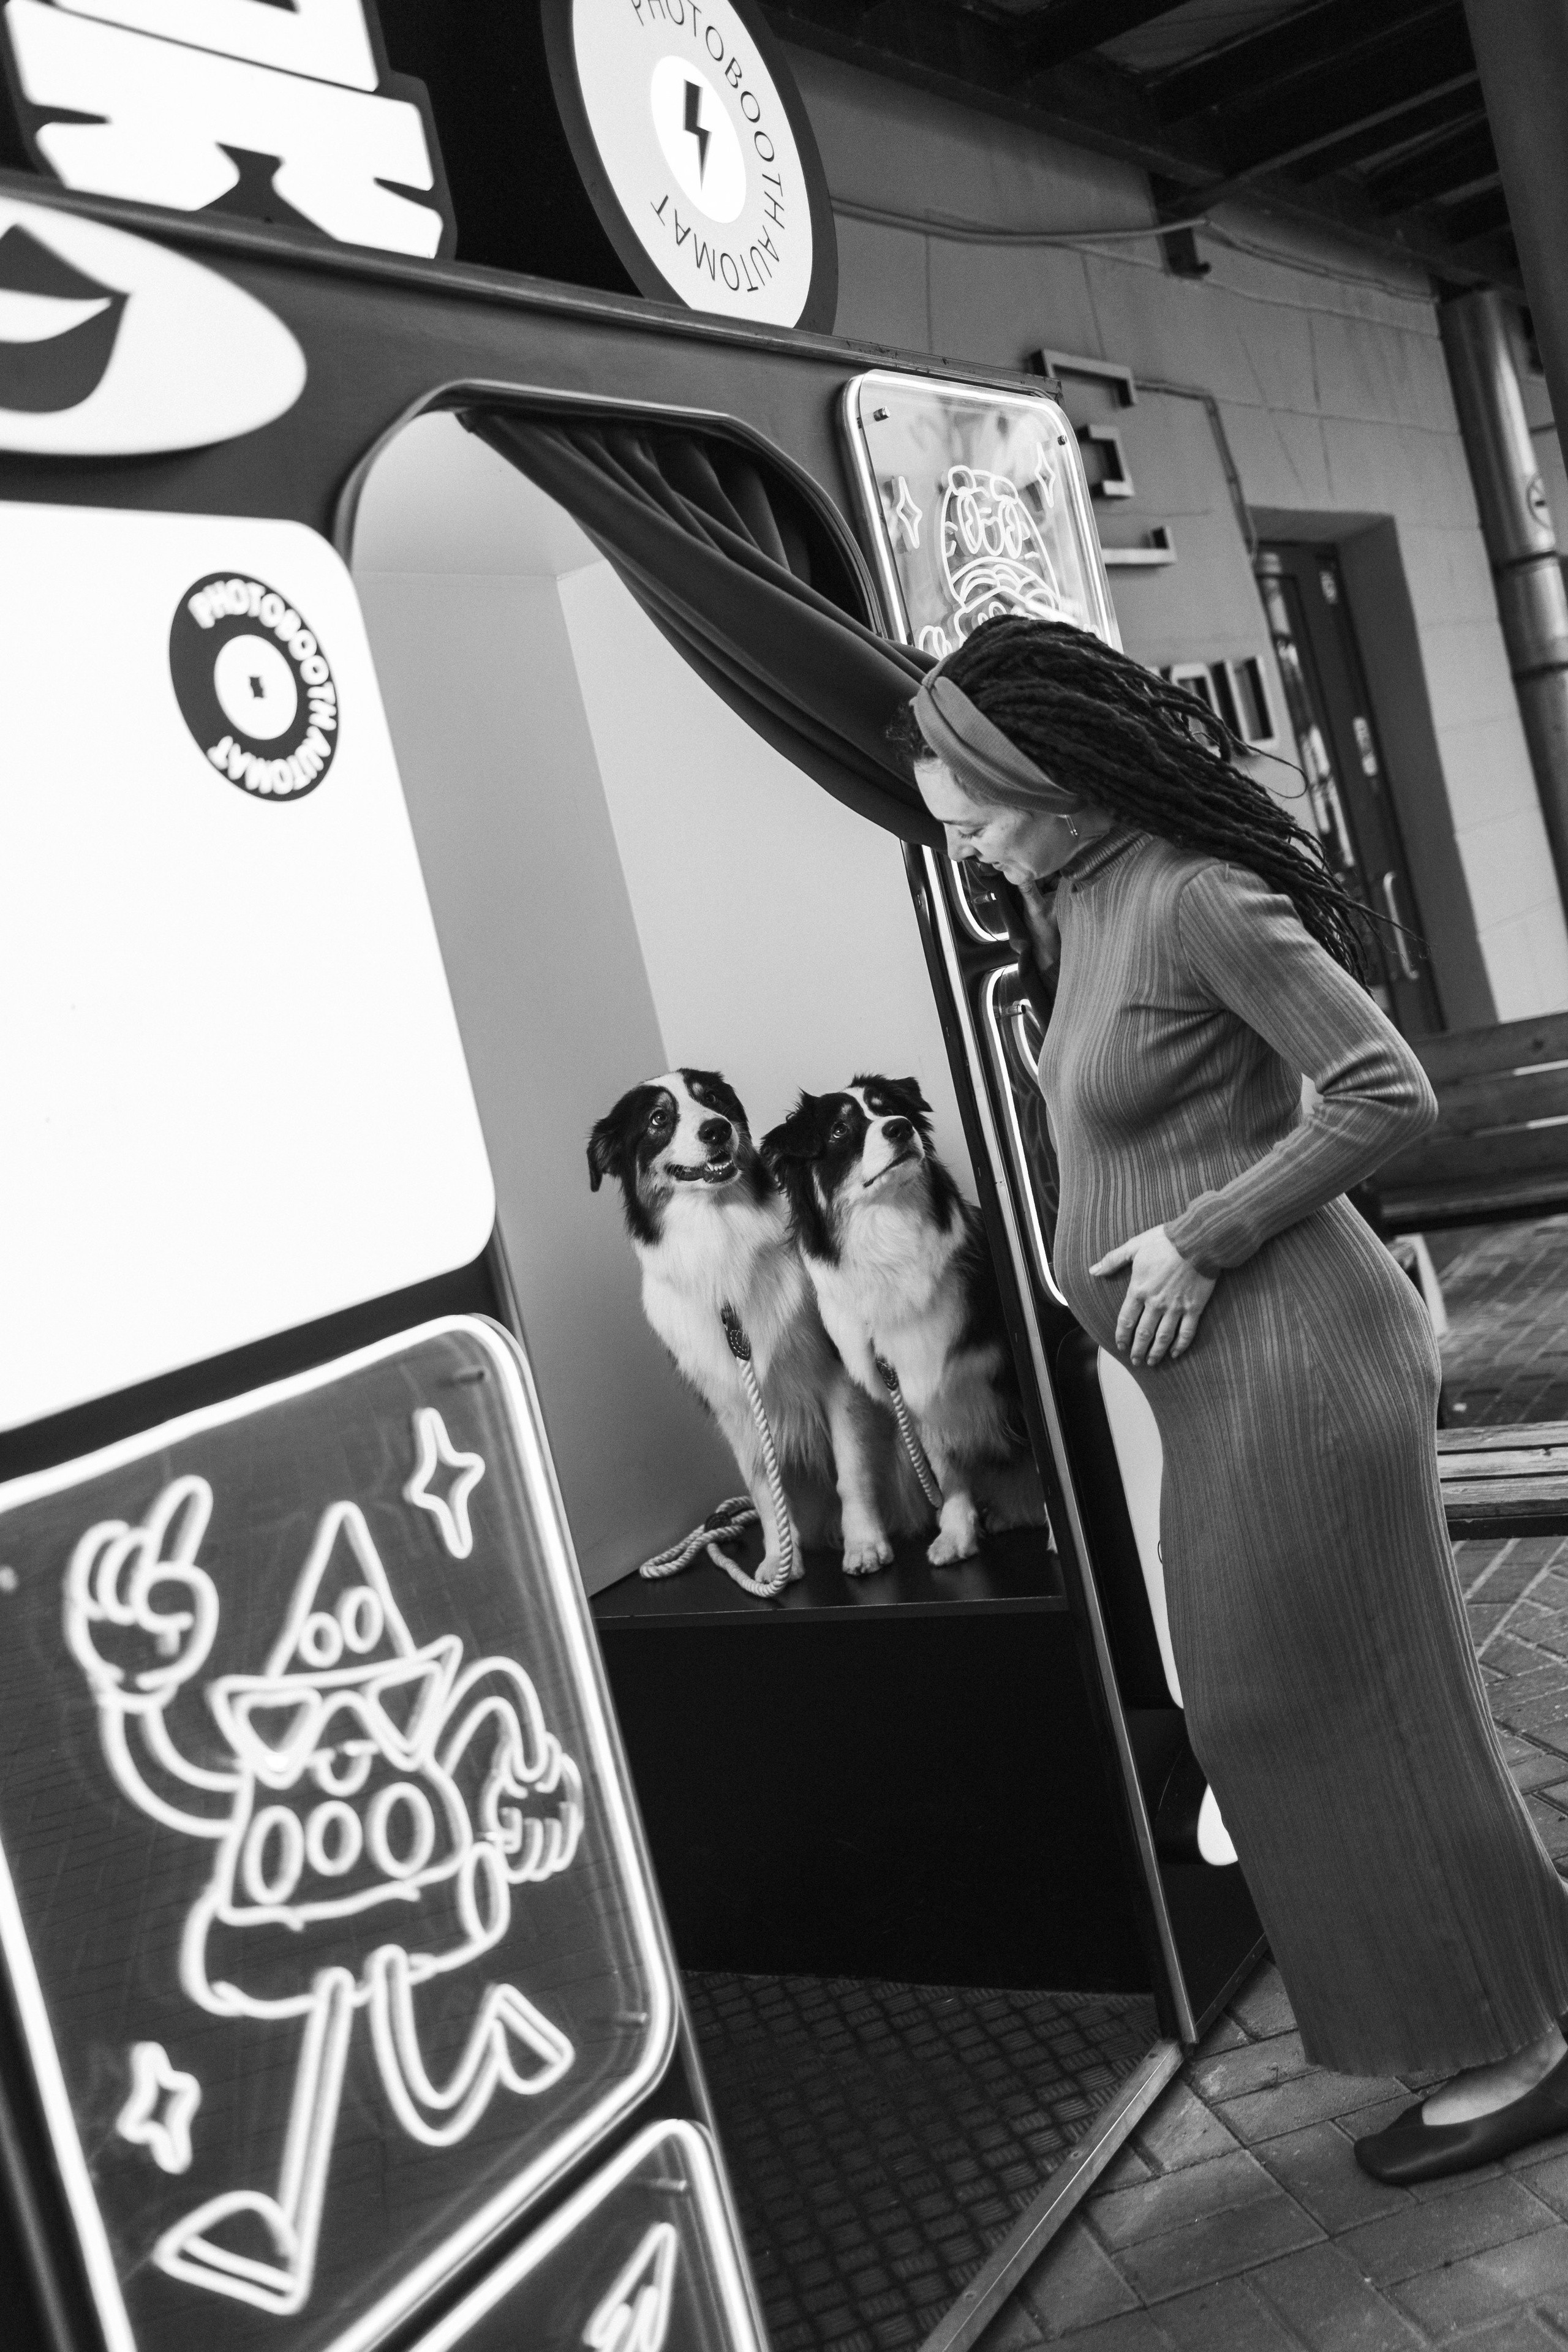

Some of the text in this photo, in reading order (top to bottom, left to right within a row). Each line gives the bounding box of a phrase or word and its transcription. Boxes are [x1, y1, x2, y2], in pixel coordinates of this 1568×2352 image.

[631, 0, 785, 292] PHOTOBOOTH AUTOMAT
[187, 579, 336, 794] PHOTOBOOTH AUTOMAT
